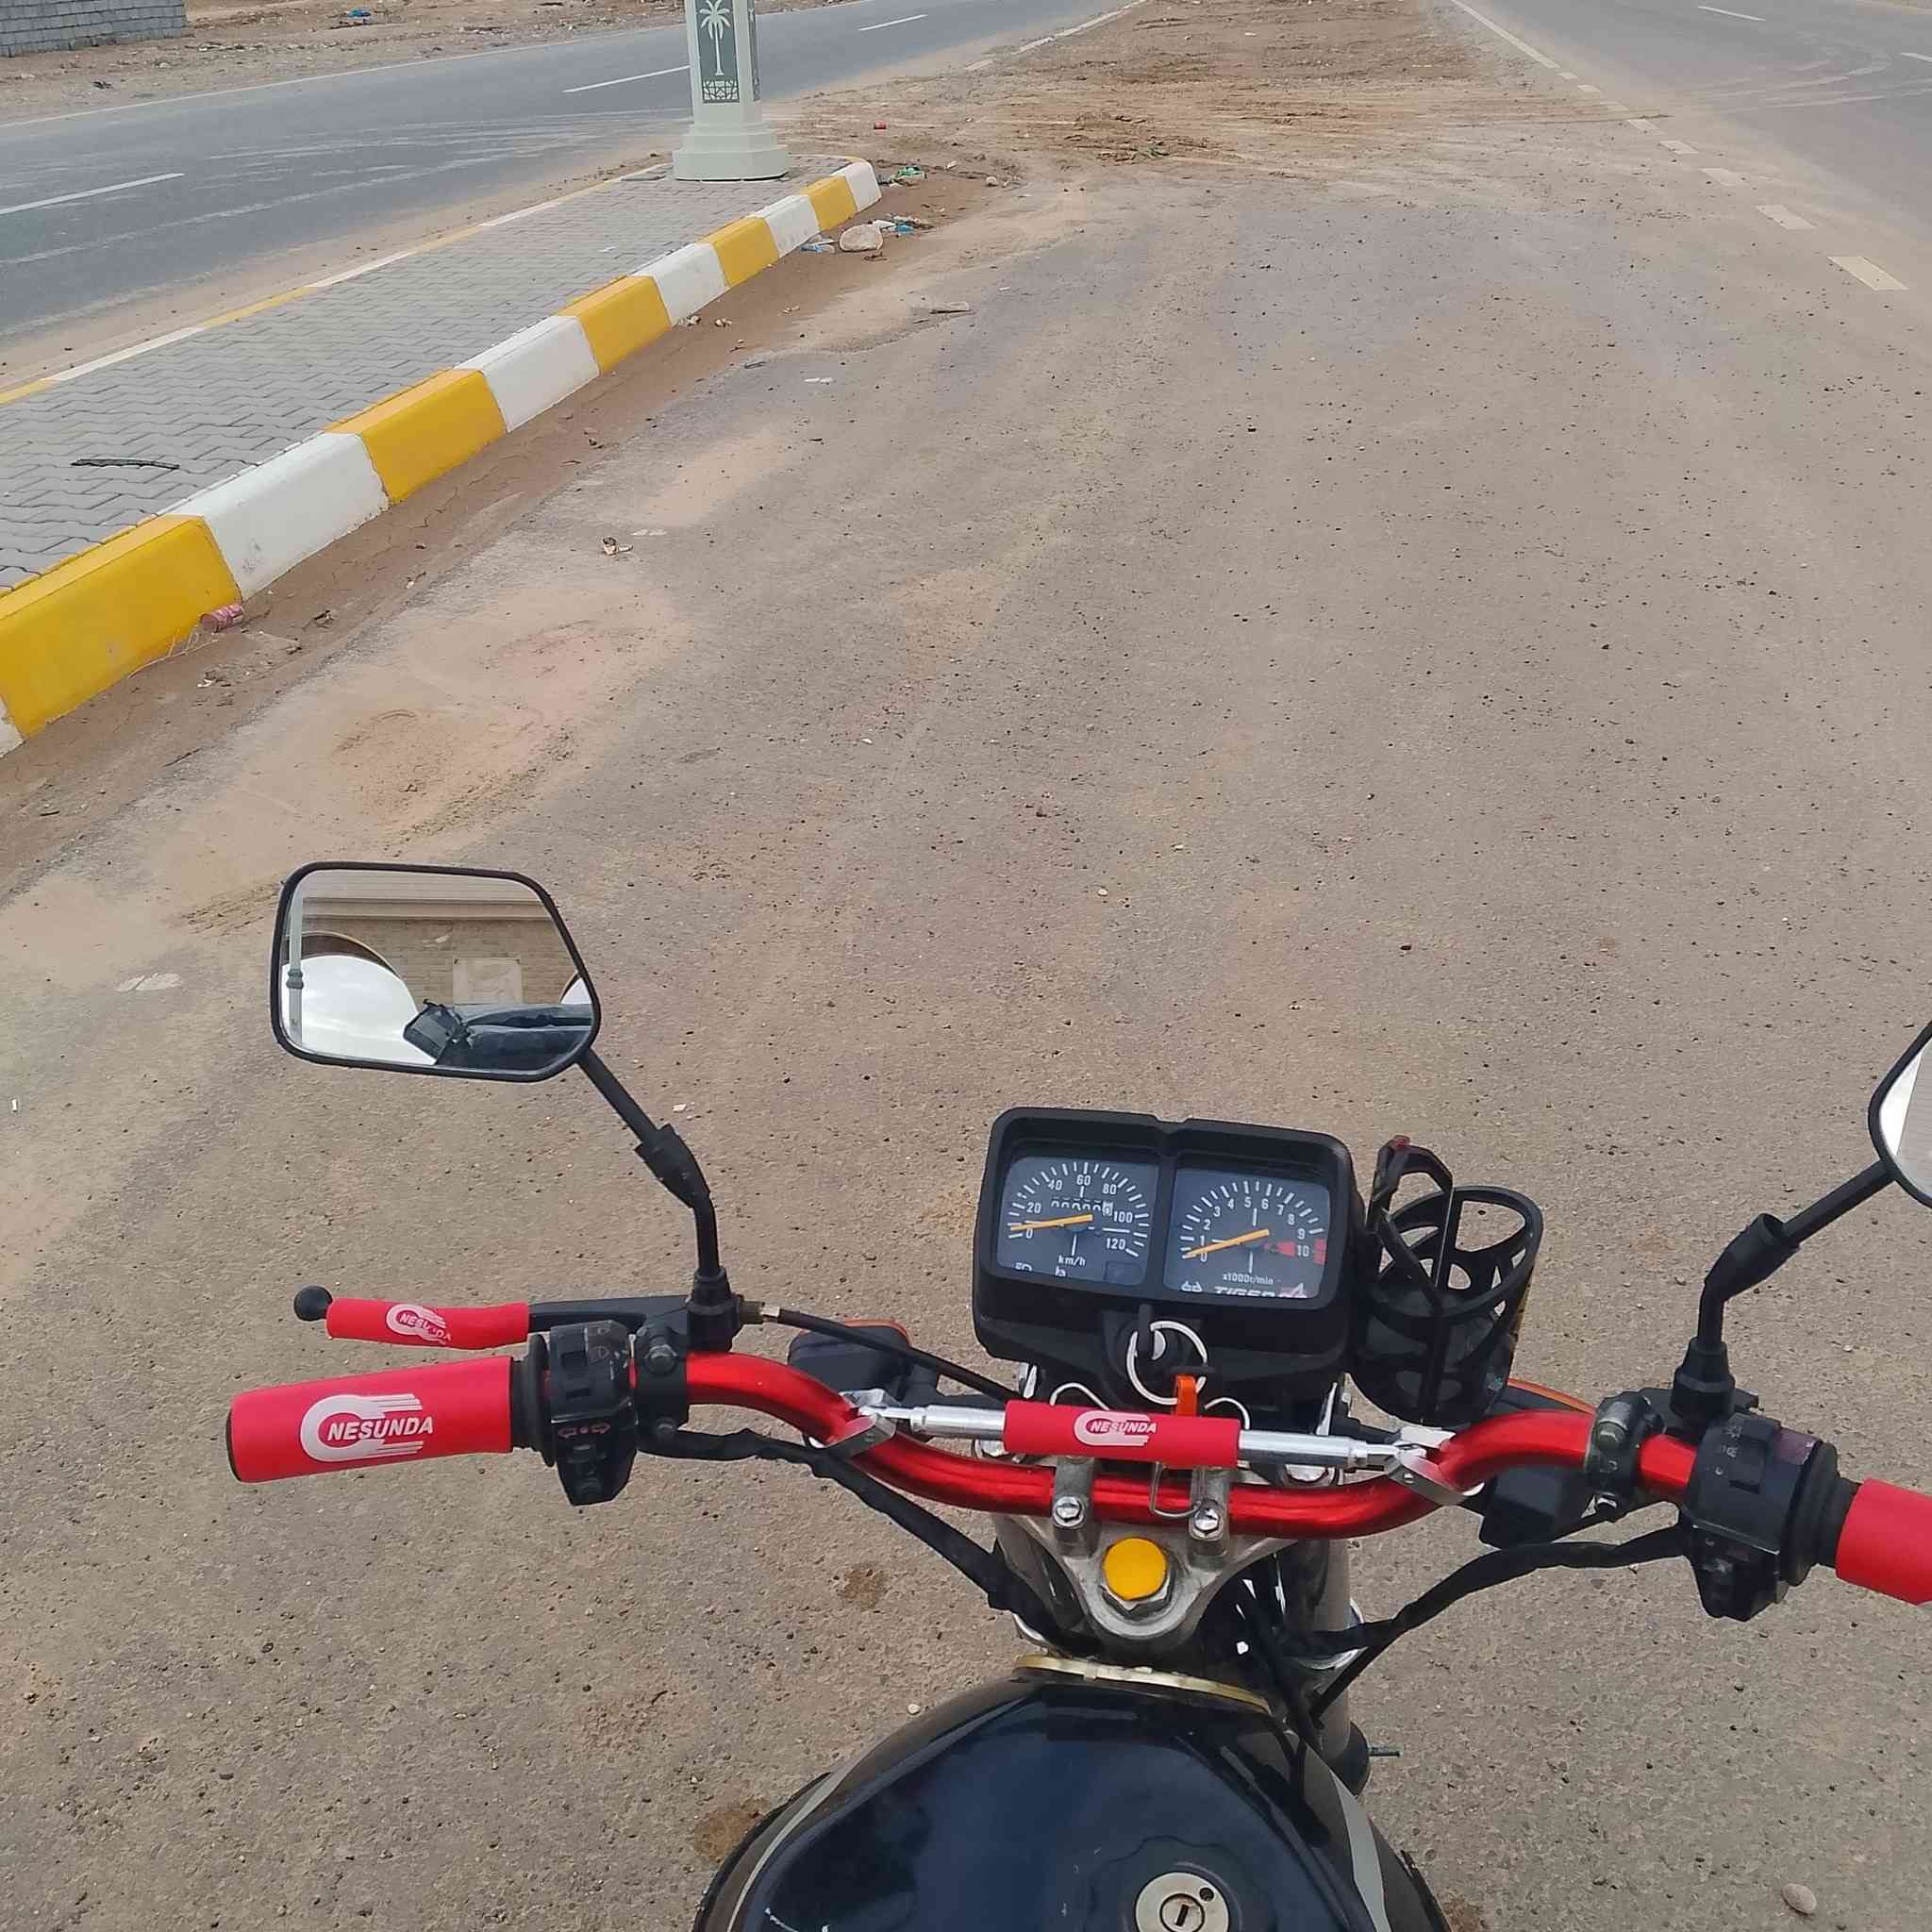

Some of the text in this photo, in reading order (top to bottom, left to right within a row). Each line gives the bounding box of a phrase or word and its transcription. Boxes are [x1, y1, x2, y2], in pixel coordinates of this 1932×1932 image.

[1047, 1179, 1063, 1191] 40
[1076, 1174, 1091, 1186] 60
[1102, 1184, 1117, 1195] 80
[1026, 1202, 1041, 1214] 20
[1227, 1198, 1235, 1209] 4
[1244, 1196, 1252, 1208] 5
[1261, 1198, 1269, 1209] 6
[1213, 1206, 1221, 1217] 3
[1277, 1204, 1285, 1215] 7
[1113, 1210, 1133, 1224] 100
[1288, 1213, 1295, 1225] 8
[1204, 1219, 1211, 1231] 2
[1025, 1228, 1033, 1240] 0
[1297, 1228, 1306, 1240] 9
[1106, 1238, 1126, 1251] 120
[1200, 1235, 1206, 1246] 1
[1297, 1244, 1309, 1257] 10
[1058, 1255, 1086, 1267] km/h
[326, 1416, 434, 1441] NESUNDA
[1091, 1420, 1157, 1434] NESUNDA
